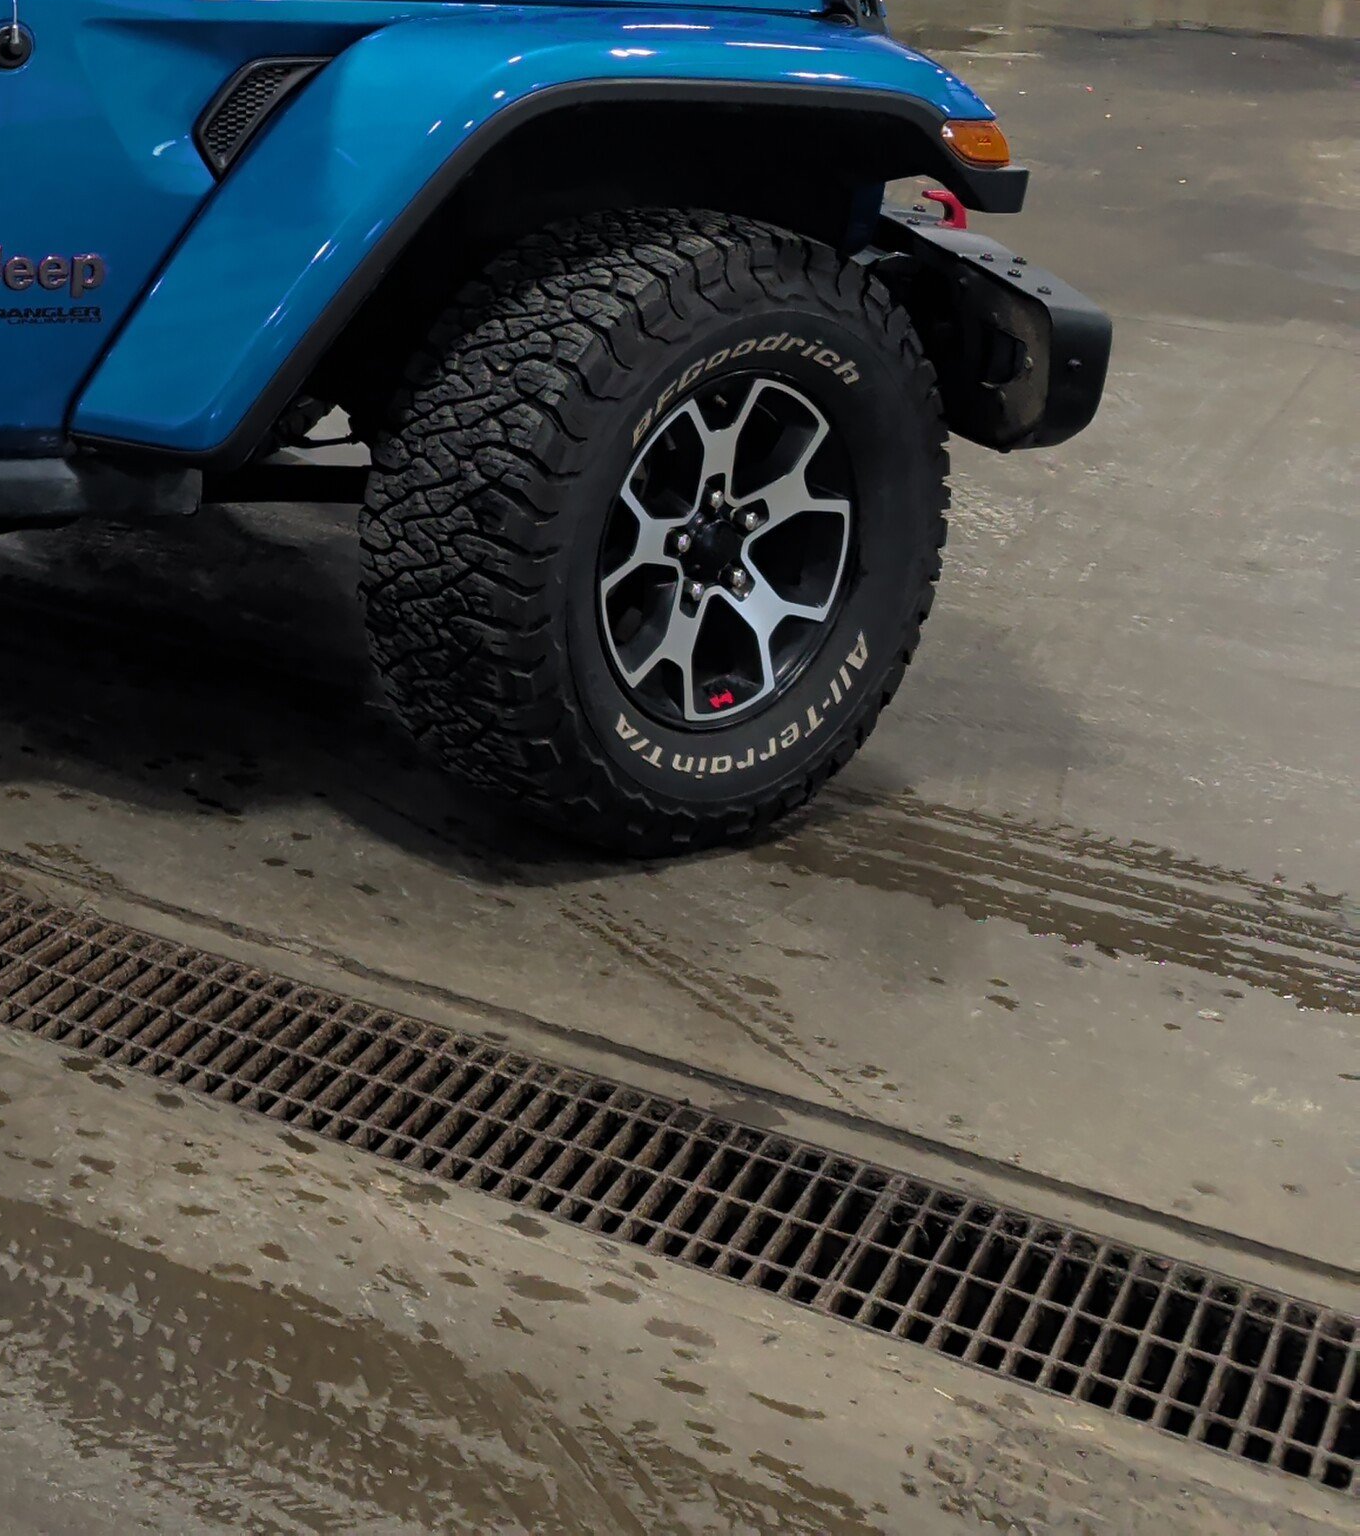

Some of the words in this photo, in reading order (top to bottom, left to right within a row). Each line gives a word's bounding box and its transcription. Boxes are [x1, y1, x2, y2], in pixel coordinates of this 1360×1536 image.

[7, 317, 102, 325] UNLIMITED
[632, 331, 862, 450] BFGoodrich
[614, 711, 663, 769] T/A
[672, 629, 868, 779] All-Terrain
